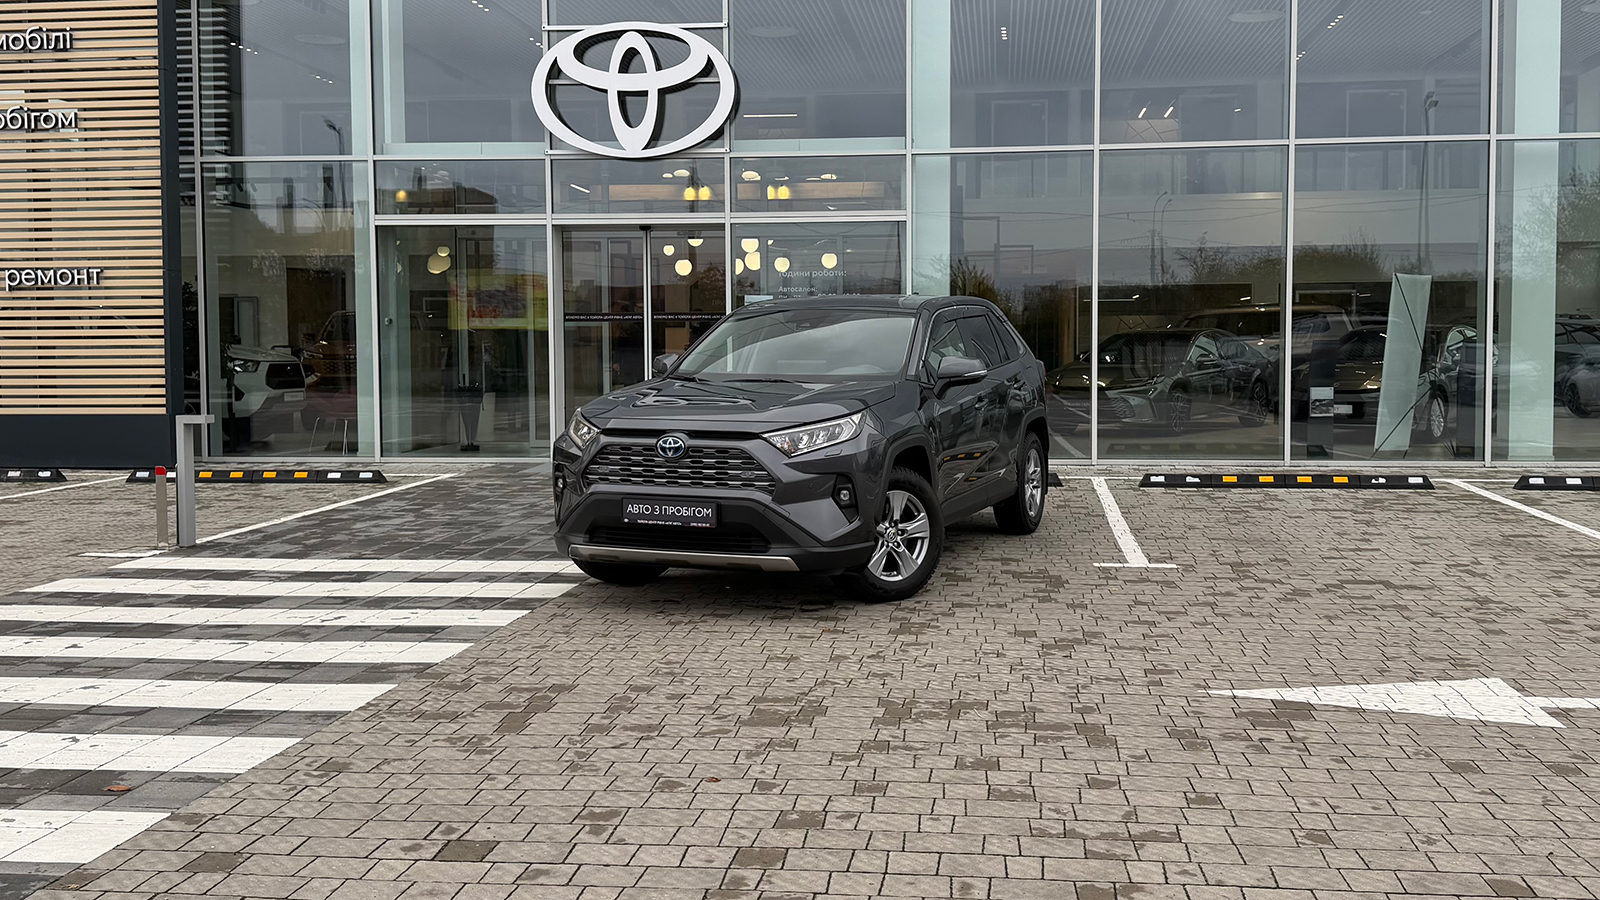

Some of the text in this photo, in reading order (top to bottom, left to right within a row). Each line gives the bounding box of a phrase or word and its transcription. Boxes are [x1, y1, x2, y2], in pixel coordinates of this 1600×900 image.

[5, 268, 101, 292] ремонт
[812, 269, 847, 278] роботи:
[626, 504, 652, 514] АВТО
[662, 506, 712, 517] ПРОБІГОМ
